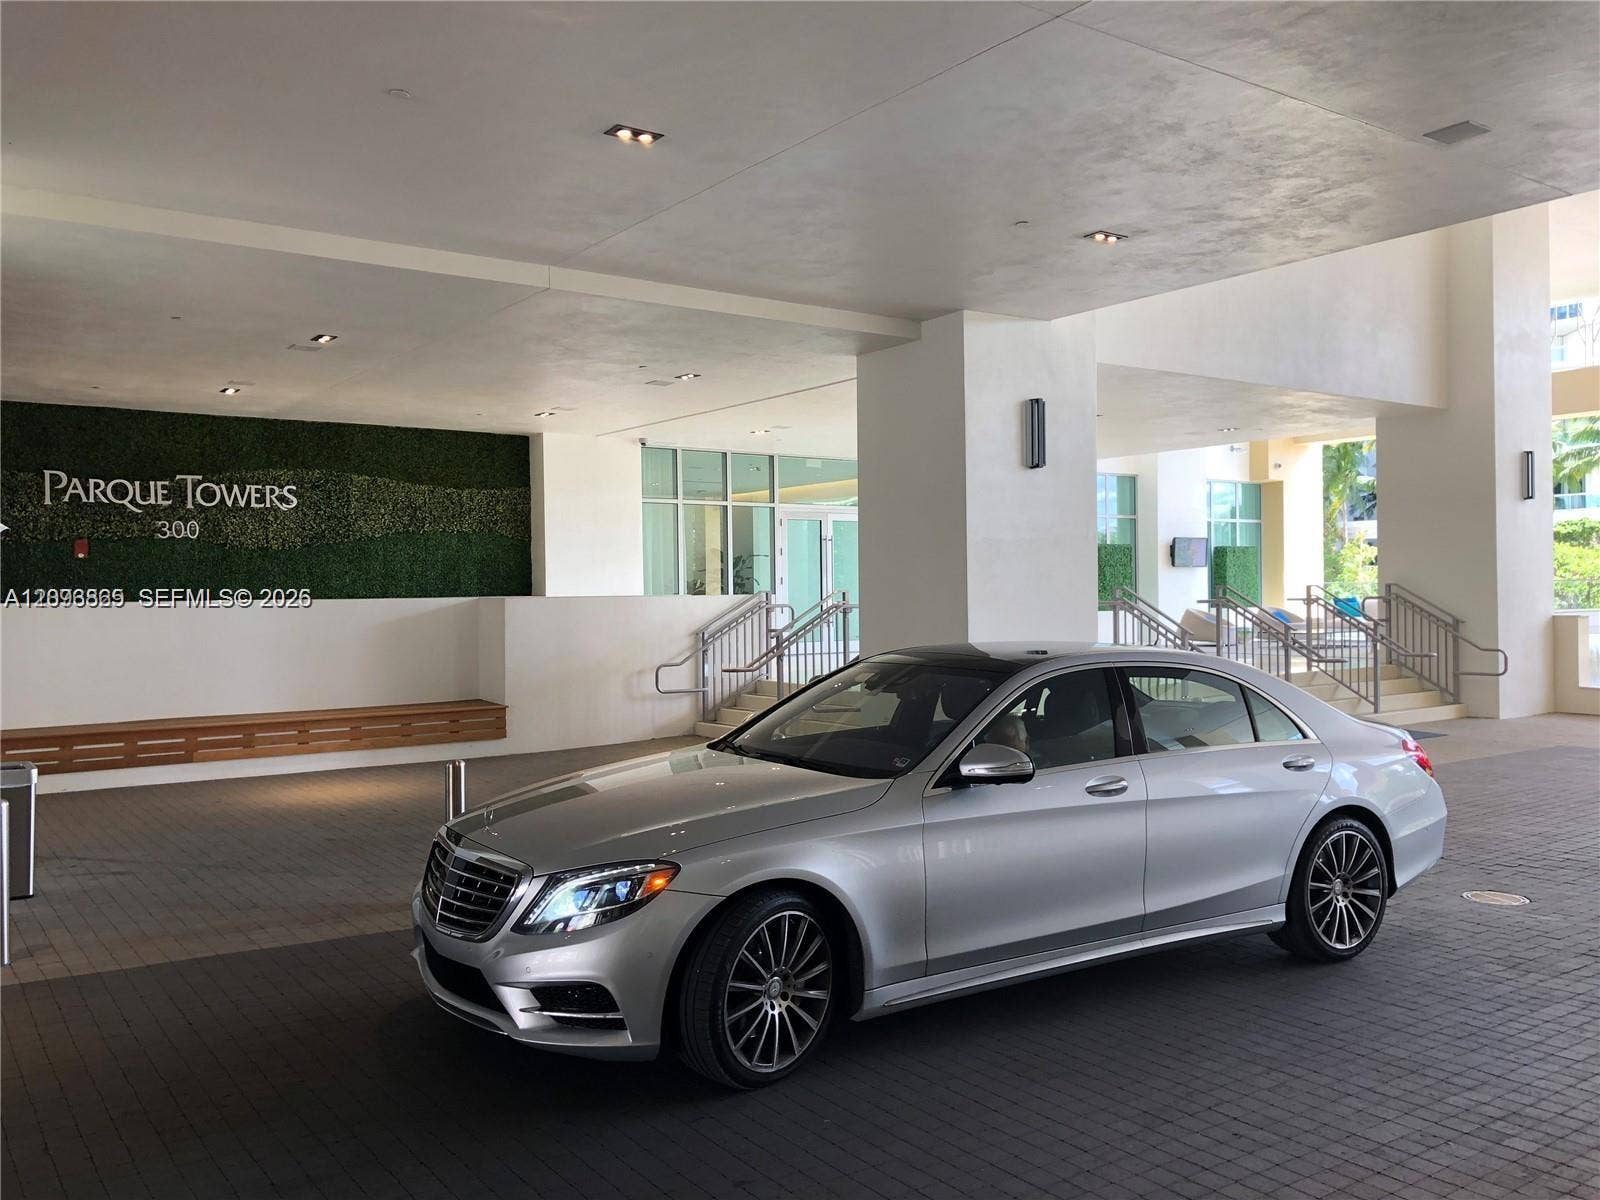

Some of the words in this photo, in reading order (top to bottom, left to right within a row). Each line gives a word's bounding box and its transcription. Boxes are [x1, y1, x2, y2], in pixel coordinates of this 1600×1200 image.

[43, 469, 173, 513] PARQUE
[175, 475, 298, 511] TOWERS
[157, 520, 200, 539] 300
